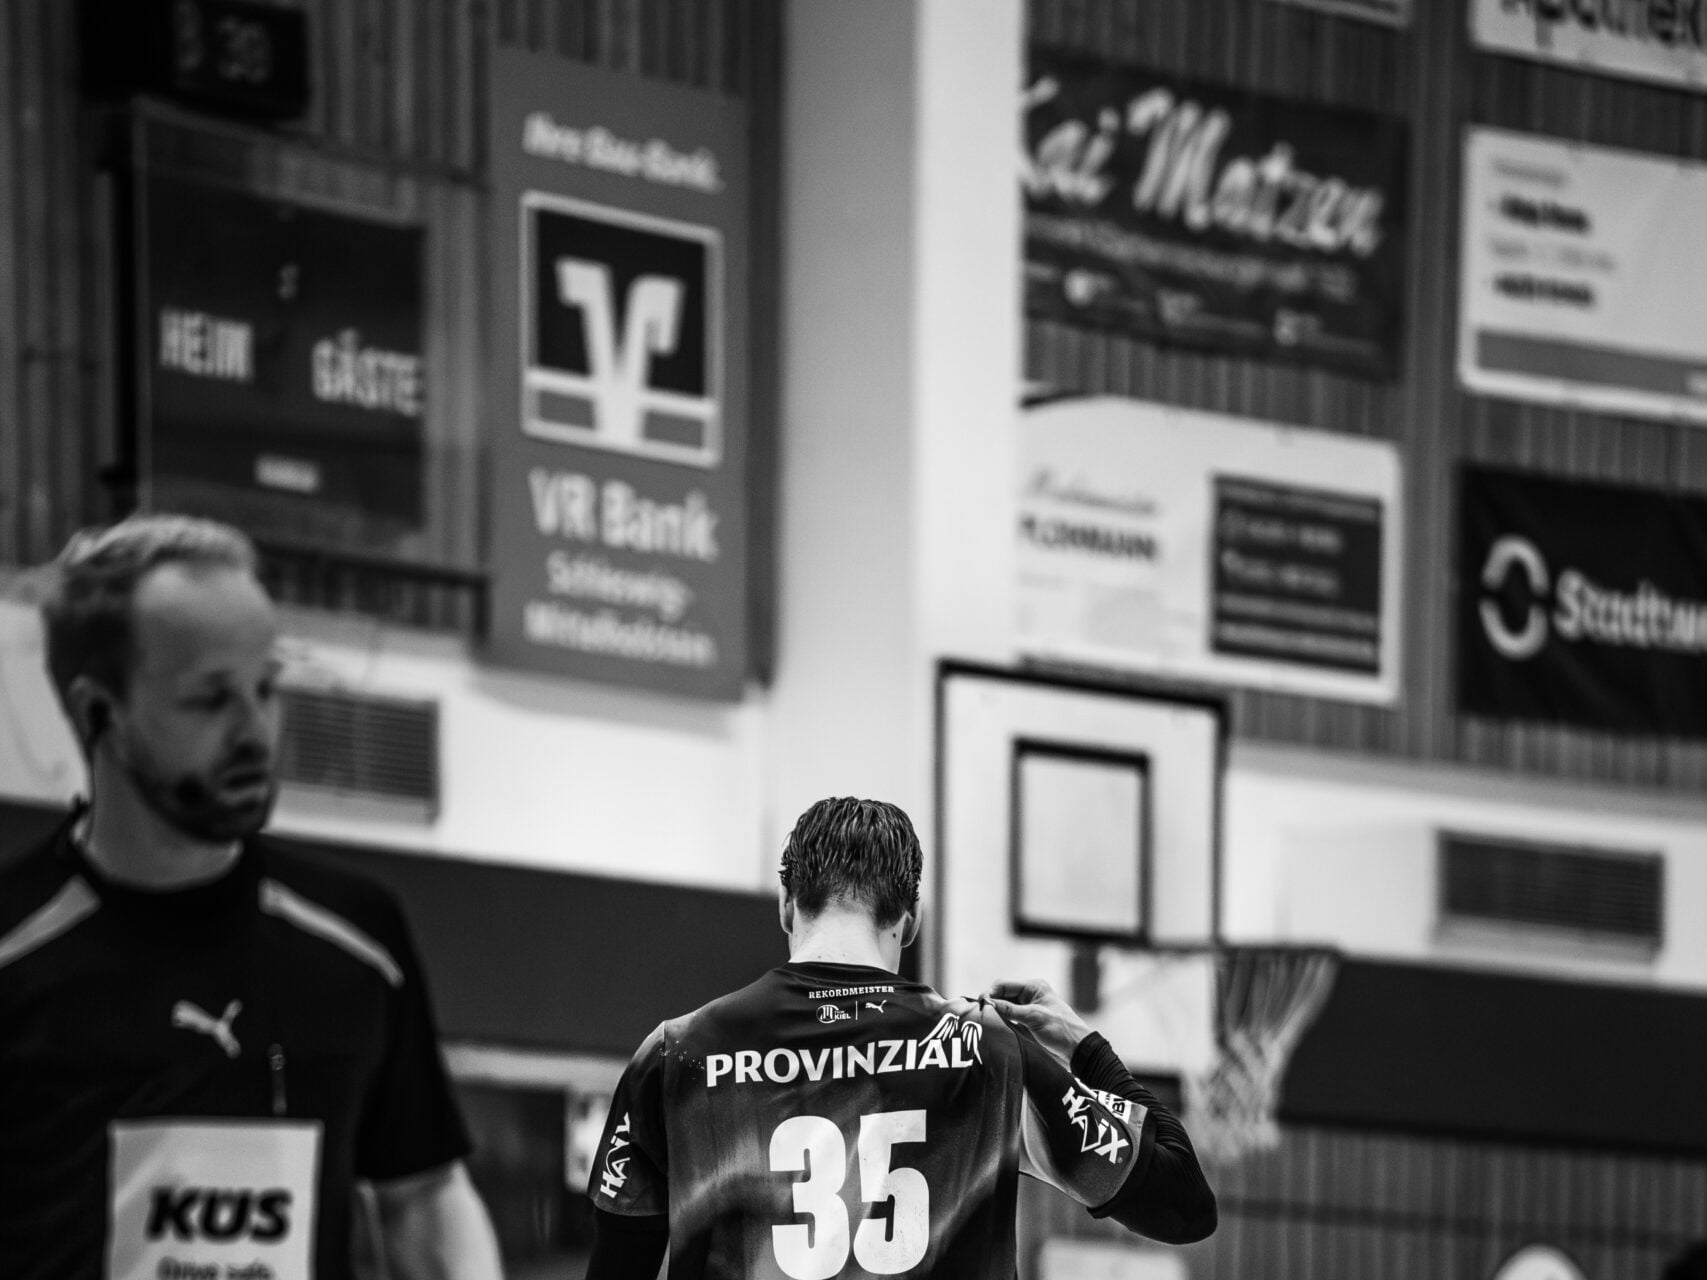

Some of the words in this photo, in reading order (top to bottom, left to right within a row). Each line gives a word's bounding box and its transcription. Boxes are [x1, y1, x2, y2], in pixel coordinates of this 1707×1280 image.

[1126, 88, 1384, 257] Matzen
[159, 304, 254, 383] HEIM
[312, 326, 425, 418] GÄSTE
[528, 465, 597, 543] VR
[600, 478, 719, 563] Bank
[808, 986, 895, 999] REKORDMEISTER
[706, 1037, 973, 1088] PROVINZIAL
[769, 1109, 930, 1280] 35
